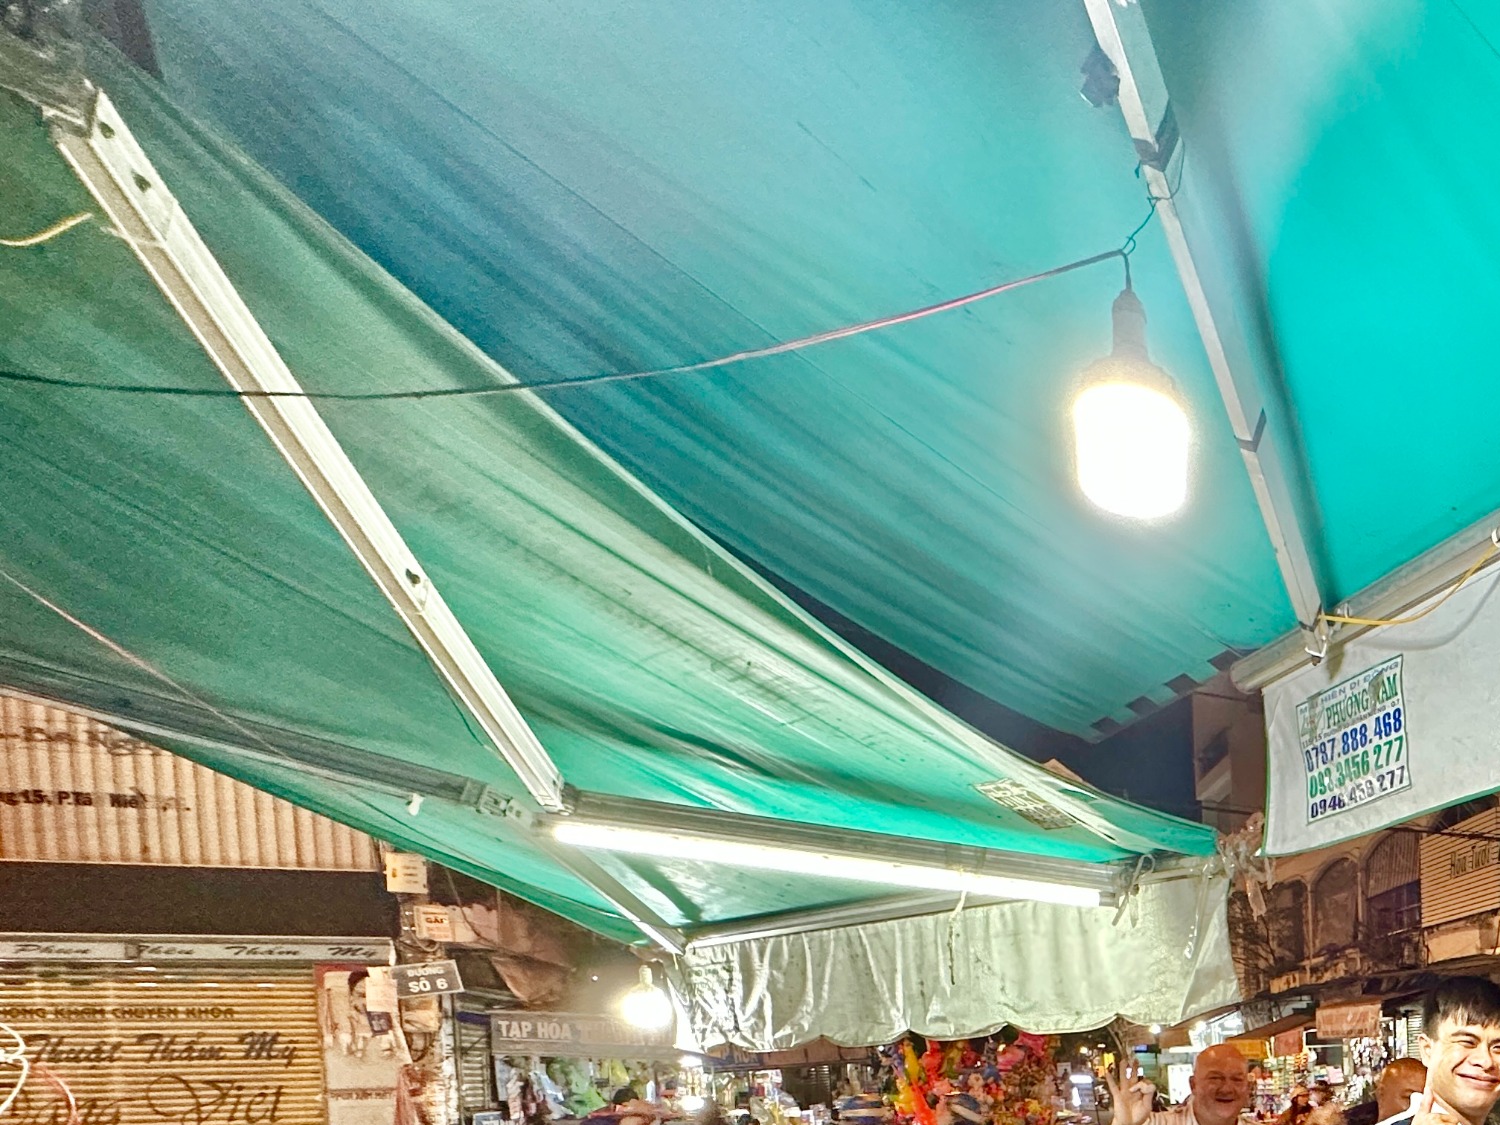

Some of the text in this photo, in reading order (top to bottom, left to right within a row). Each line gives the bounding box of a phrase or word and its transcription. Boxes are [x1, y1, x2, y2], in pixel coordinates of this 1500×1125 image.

[1349, 679, 1360, 691] DI
[1373, 735, 1404, 770] 277
[1376, 765, 1405, 792] 277
[408, 976, 449, 993] SỐ 6
